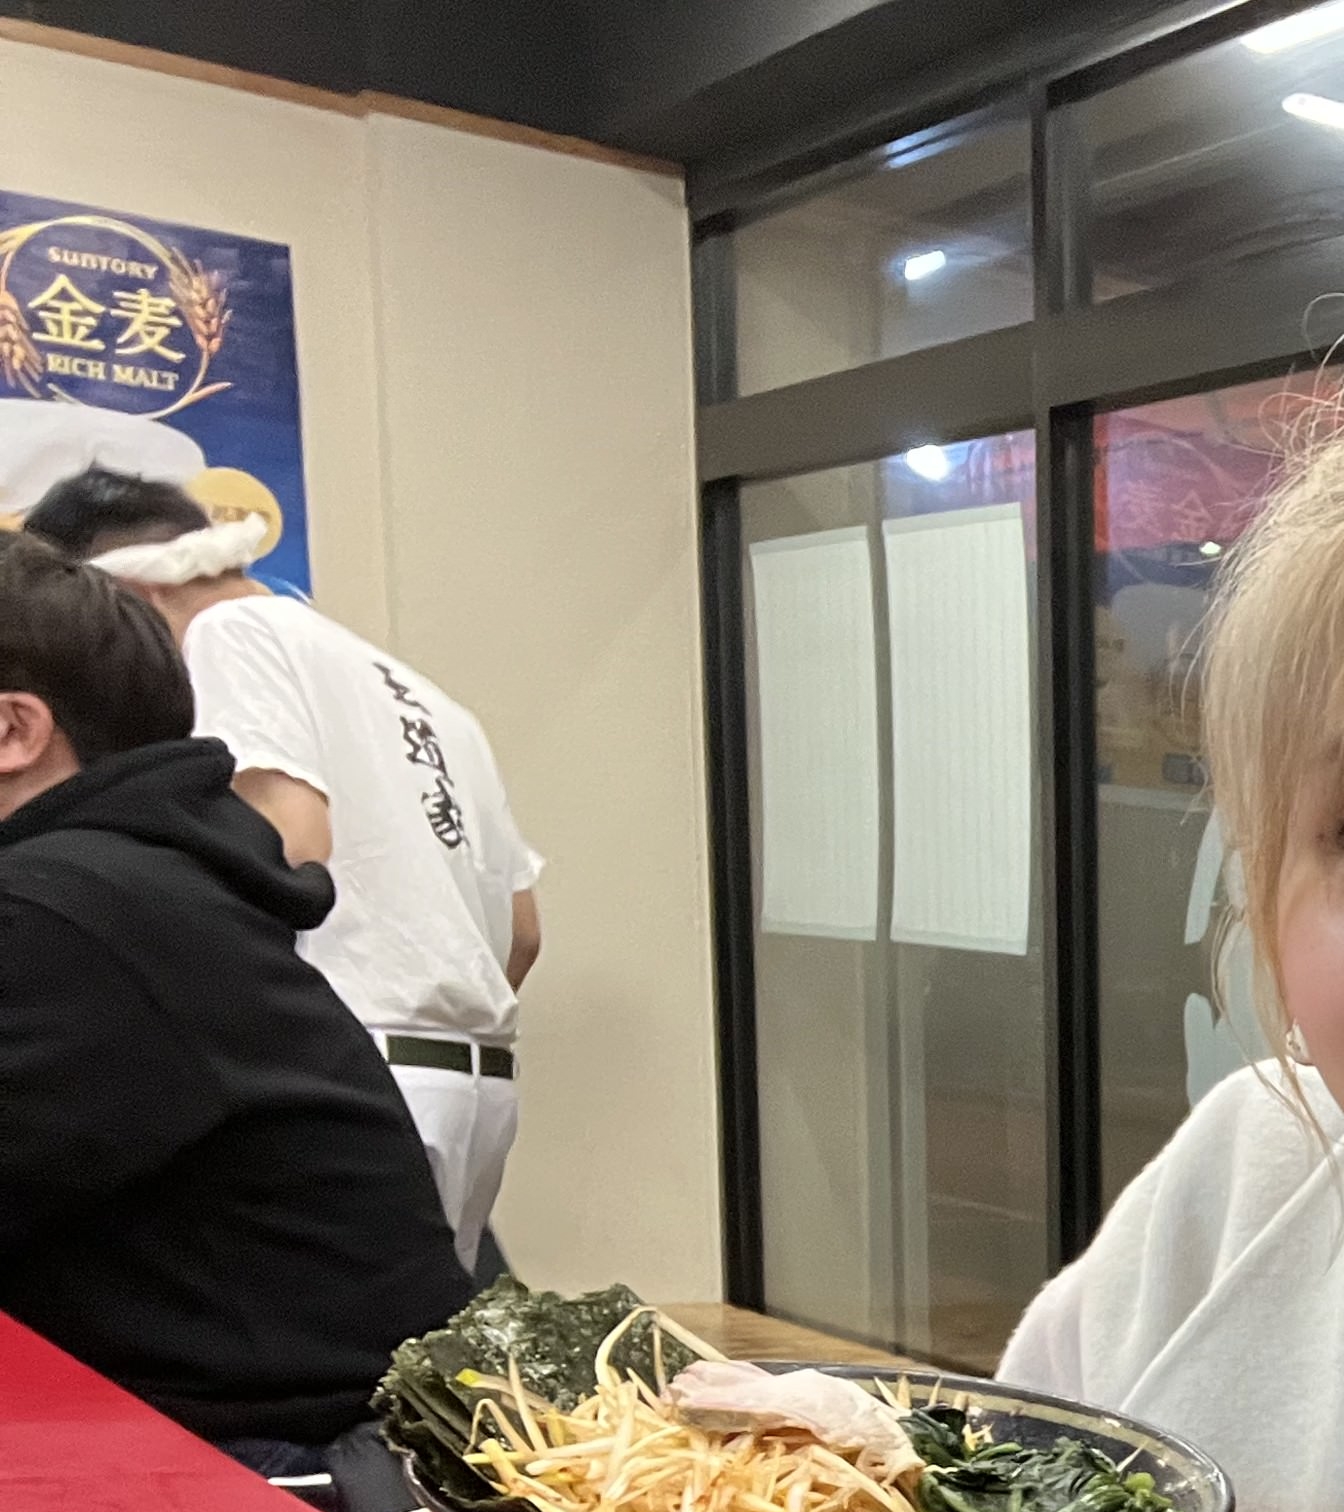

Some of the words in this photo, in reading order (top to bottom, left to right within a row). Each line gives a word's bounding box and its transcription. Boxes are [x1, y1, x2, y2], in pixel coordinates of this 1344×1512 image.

[27, 273, 186, 364] 金麦
[47, 353, 107, 380] RICH
[111, 364, 180, 391] MALT
